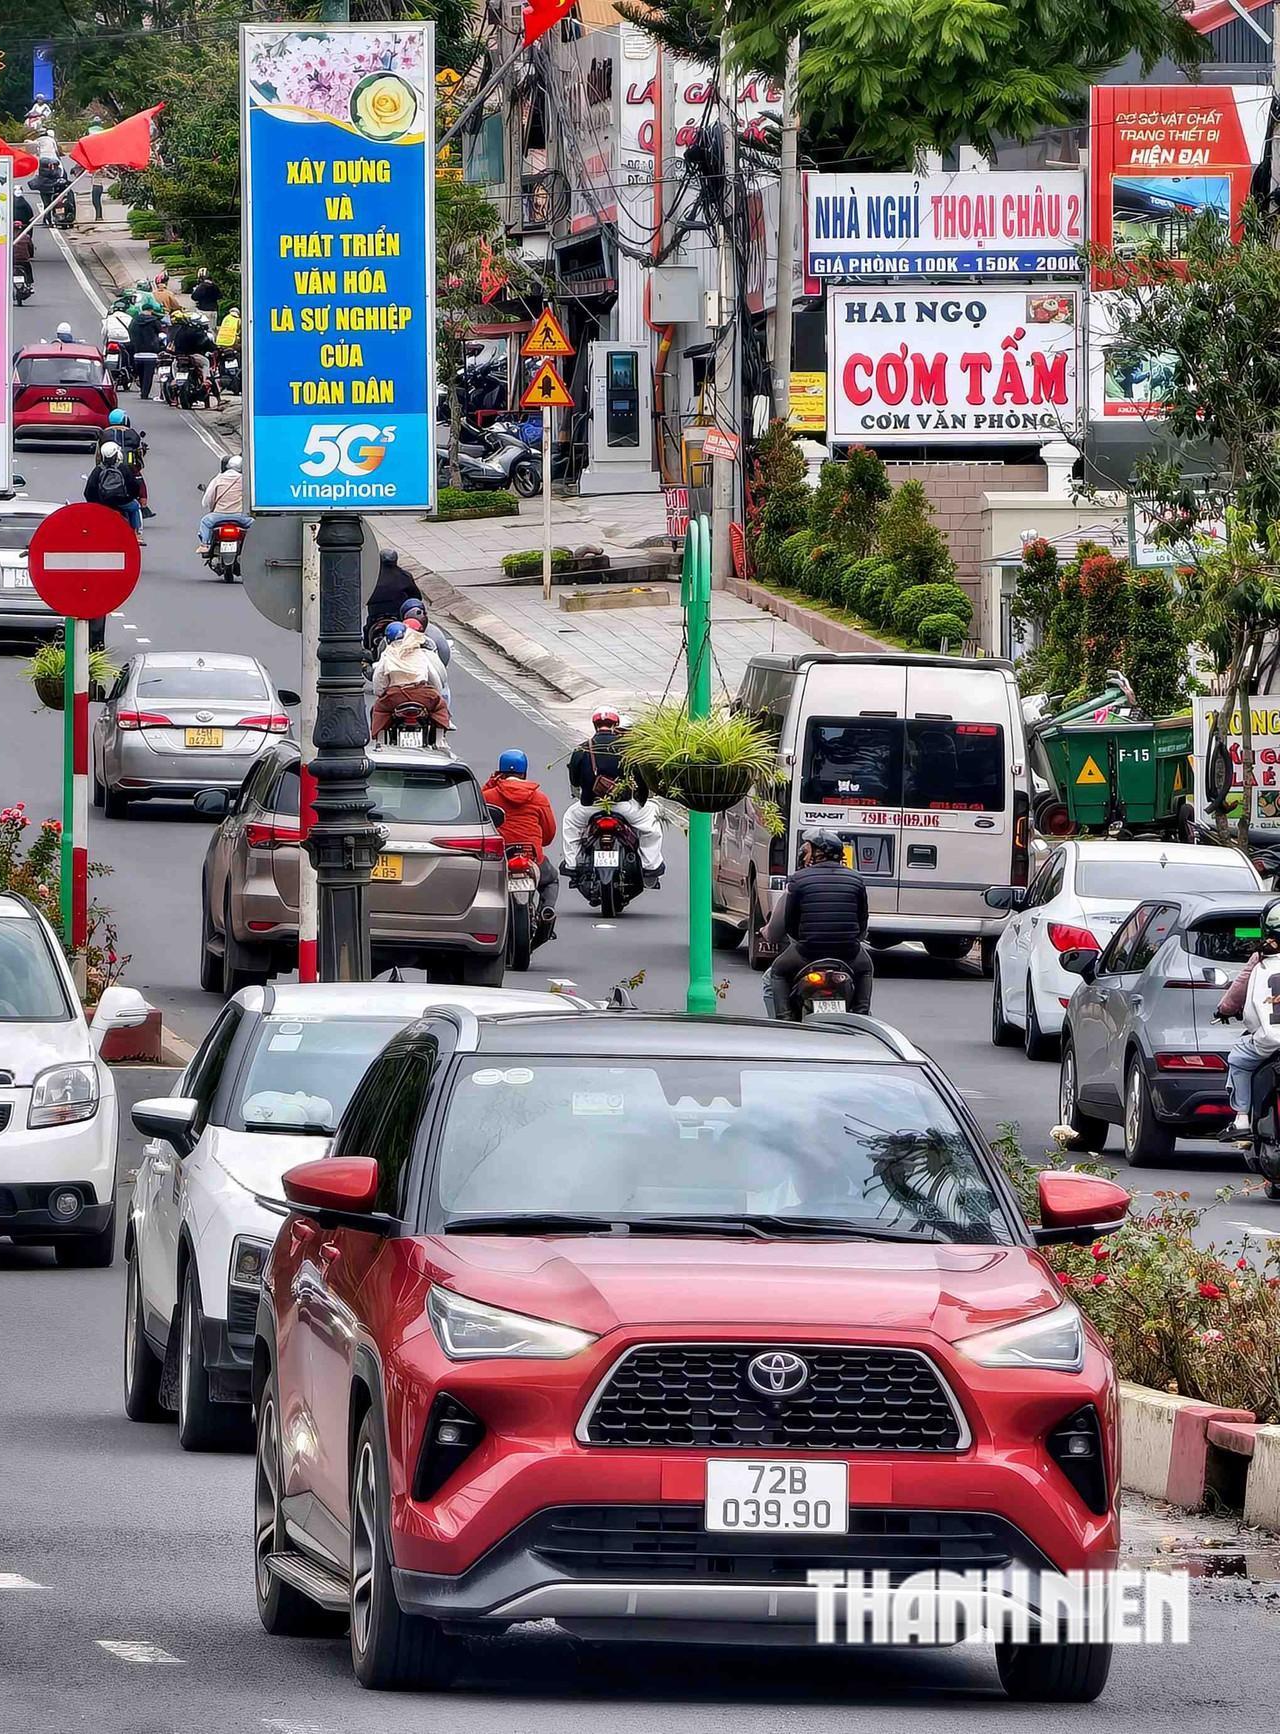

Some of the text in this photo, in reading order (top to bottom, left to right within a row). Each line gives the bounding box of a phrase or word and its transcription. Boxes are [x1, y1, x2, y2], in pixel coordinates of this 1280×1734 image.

[1187, 109, 1223, 125] CHẤT
[1120, 125, 1220, 143] TRANG THIẾT BỊ
[1130, 144, 1210, 168] HIỆN ĐẠI
[286, 156, 391, 187] XÂY DỰNG
[325, 194, 354, 221] VÀ
[815, 180, 1081, 249] NHÀ NGHỈ THOẠI CHÂU 2
[279, 225, 400, 258] PHÁT TRIỂN
[814, 255, 844, 273] GIÁ
[852, 253, 910, 273] PHÒNG
[915, 257, 959, 272] 100K
[976, 257, 1019, 272] 150K
[1036, 256, 1081, 272] 200K
[294, 267, 387, 295] VĂN HÓA
[271, 303, 413, 335] LÀ SỰ NGHIỆP
[844, 300, 987, 328] HAI NGỌ
[320, 338, 364, 368] CỦA
[842, 341, 949, 406] CƠM
[960, 326, 1069, 406] TẤM
[289, 376, 394, 405] TOÀN DÂN
[860, 409, 1056, 430] CƠM VĂN PHÒNG
[289, 480, 398, 501] vinaphone
[1119, 749, 1150, 762] F-15
[804, 811, 845, 820] TRANSIT
[746, 1465, 808, 1495] 72B
[722, 1498, 832, 1530] 039.90
